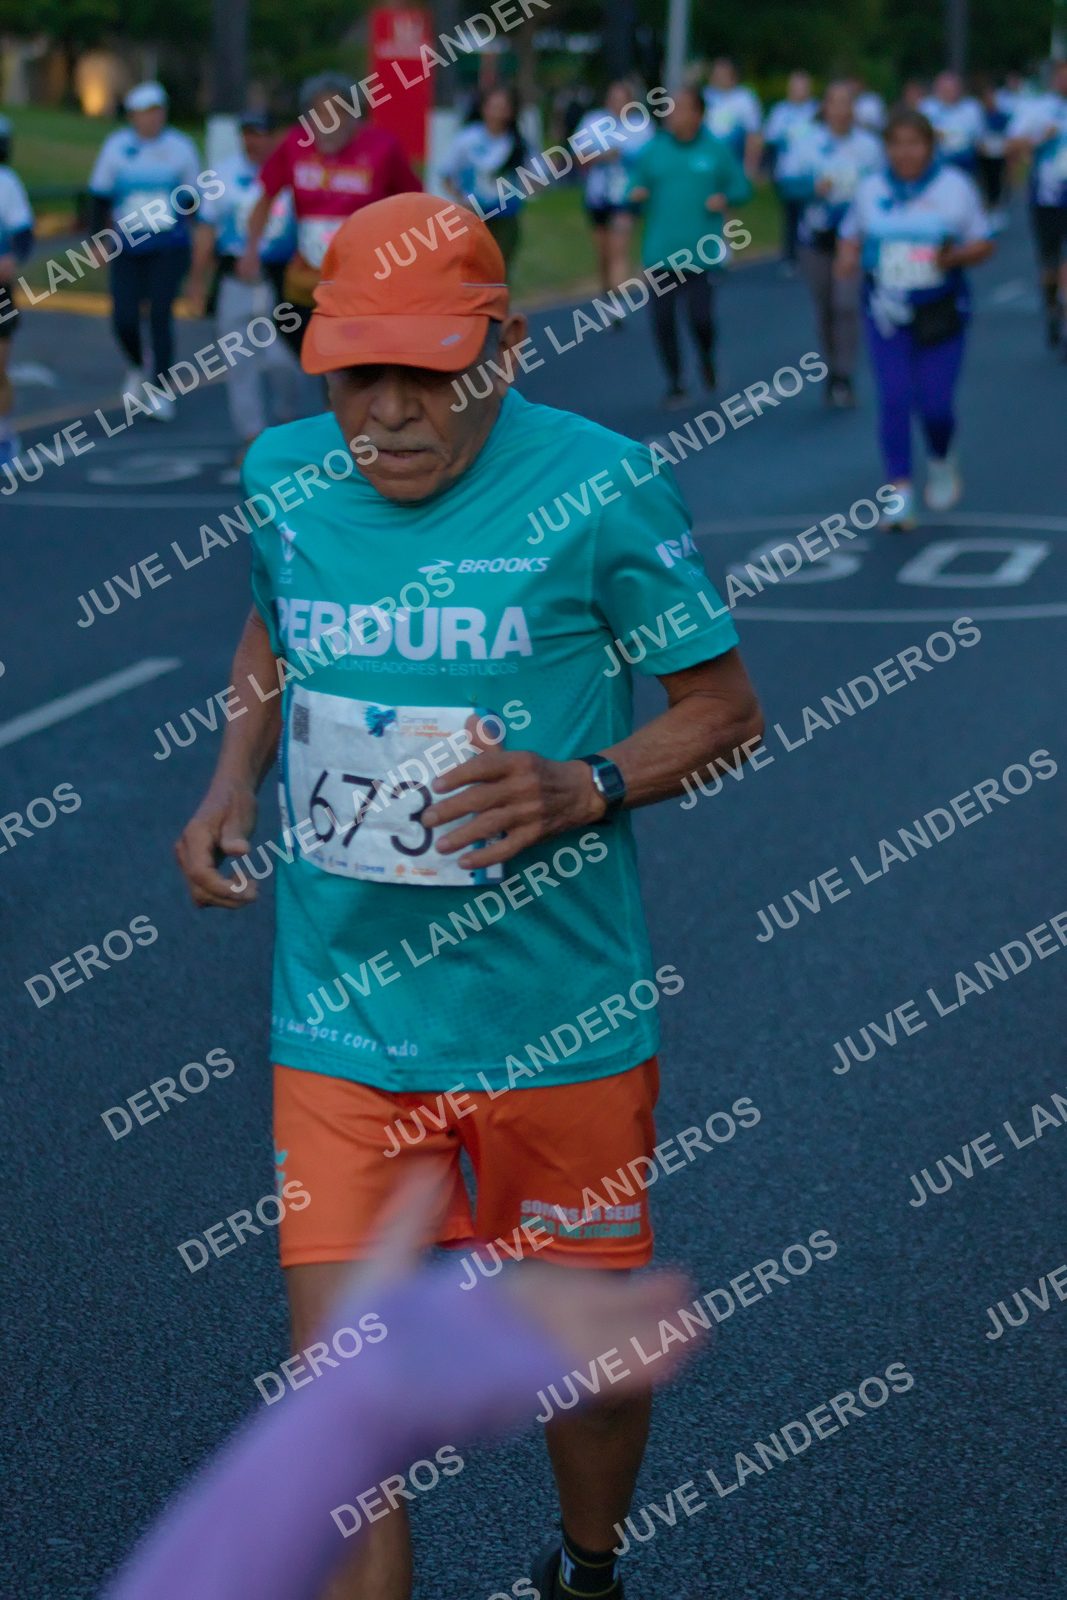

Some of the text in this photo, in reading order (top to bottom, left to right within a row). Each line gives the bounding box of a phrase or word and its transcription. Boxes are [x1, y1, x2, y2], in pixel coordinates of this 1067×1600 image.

[457, 557, 551, 573] BROOKS
[449, 662, 519, 676] ESTUCOS
[310, 769, 433, 857] 673
